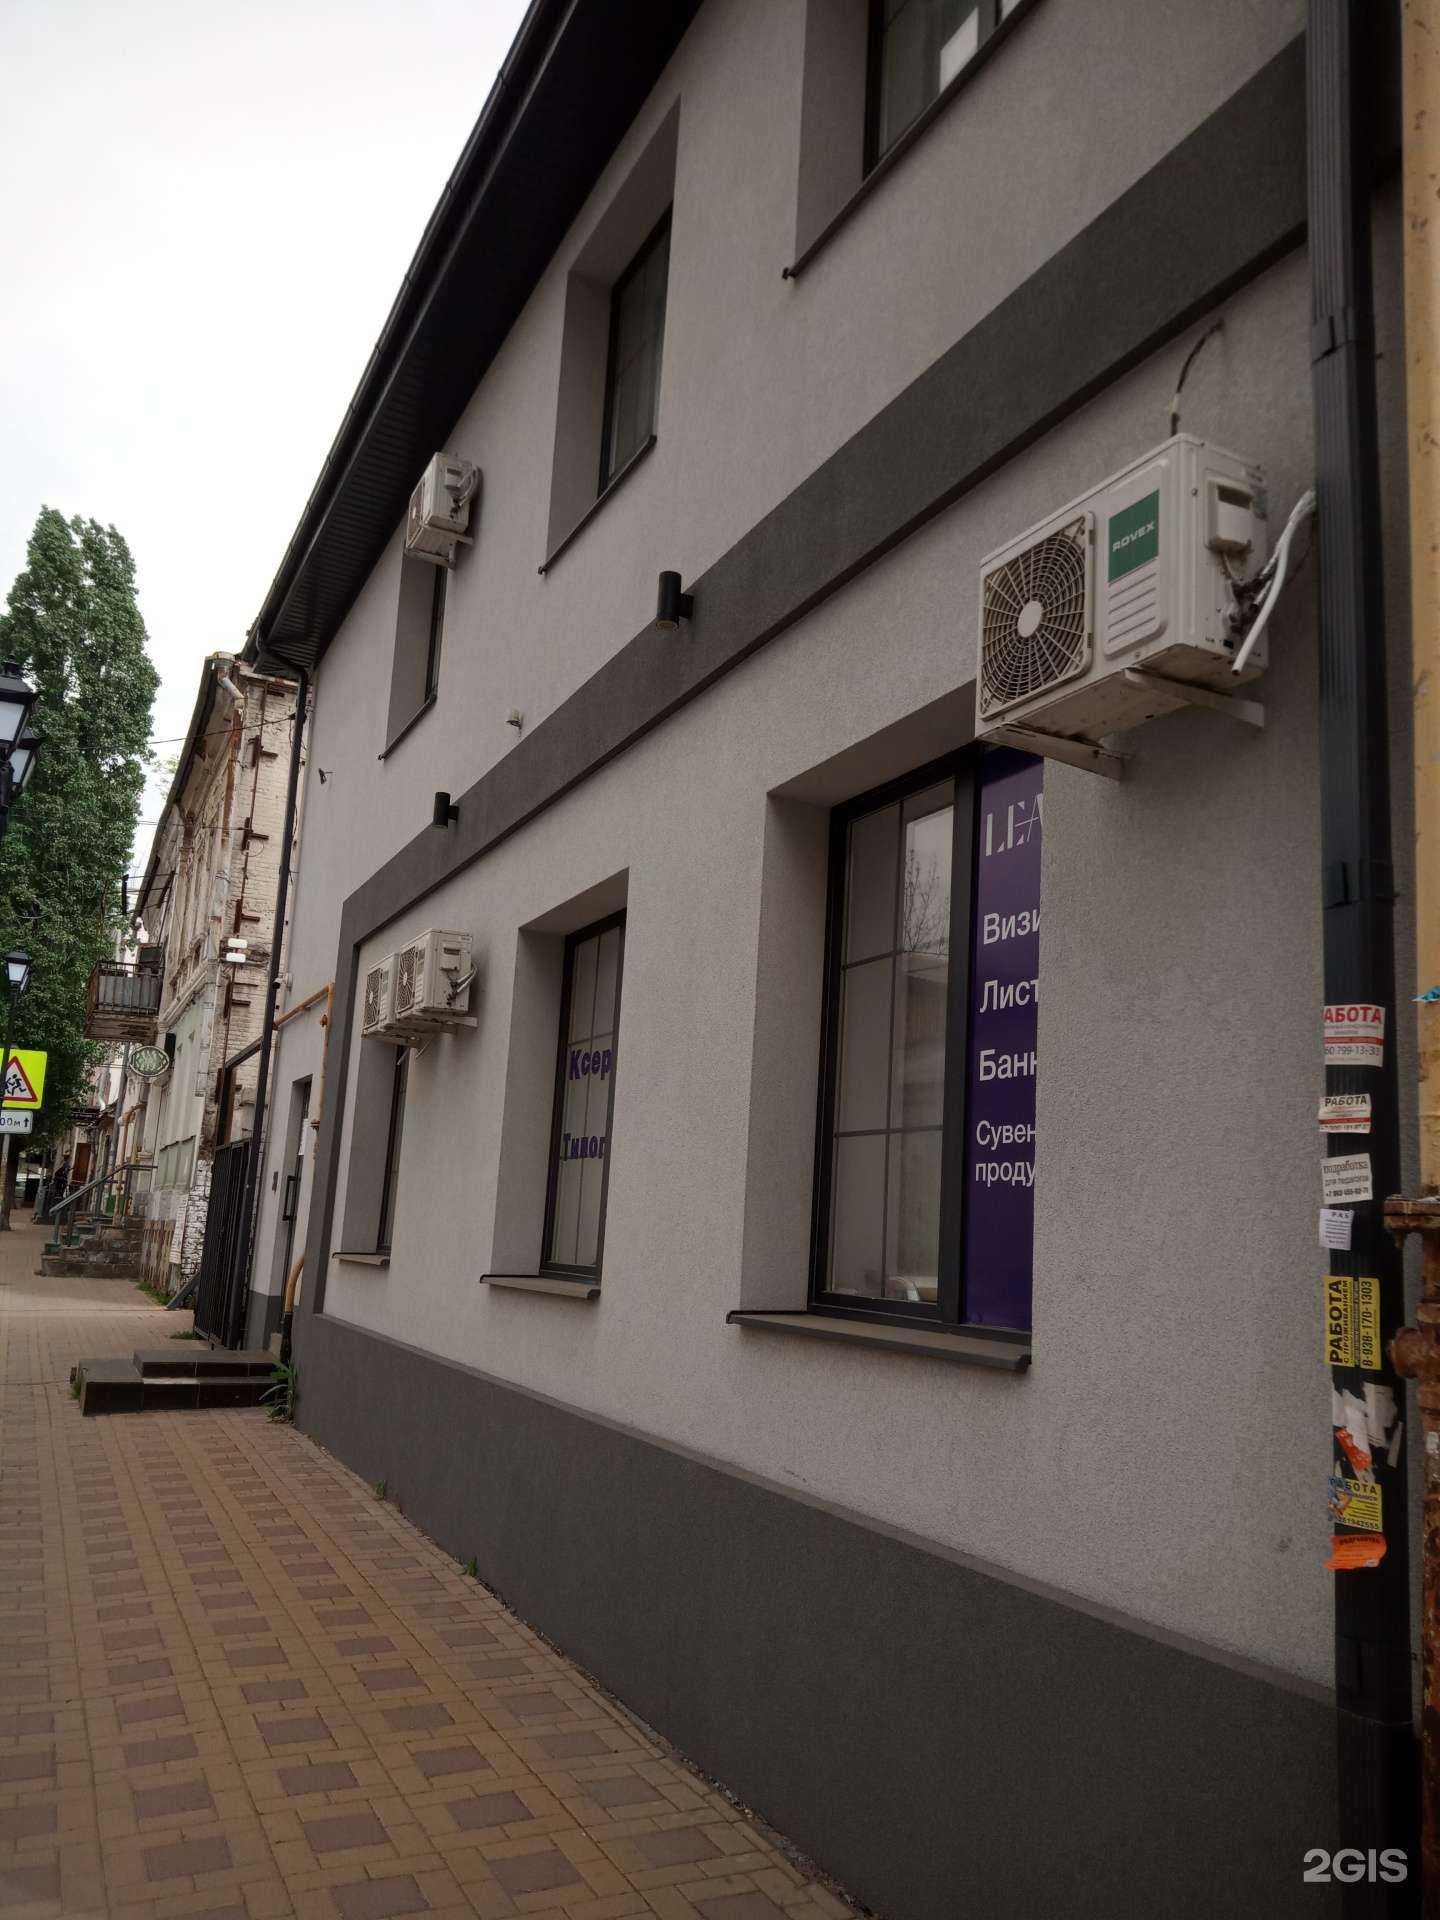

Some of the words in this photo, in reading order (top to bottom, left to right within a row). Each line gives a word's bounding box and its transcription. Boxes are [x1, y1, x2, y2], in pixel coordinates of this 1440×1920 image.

[1112, 521, 1154, 552] ROVEX
[569, 1049, 614, 1080] Ксер
[1325, 1096, 1367, 1106] РАБОТА
[975, 1161, 1035, 1187] проду
[1328, 1280, 1343, 1363] РАБОТА
